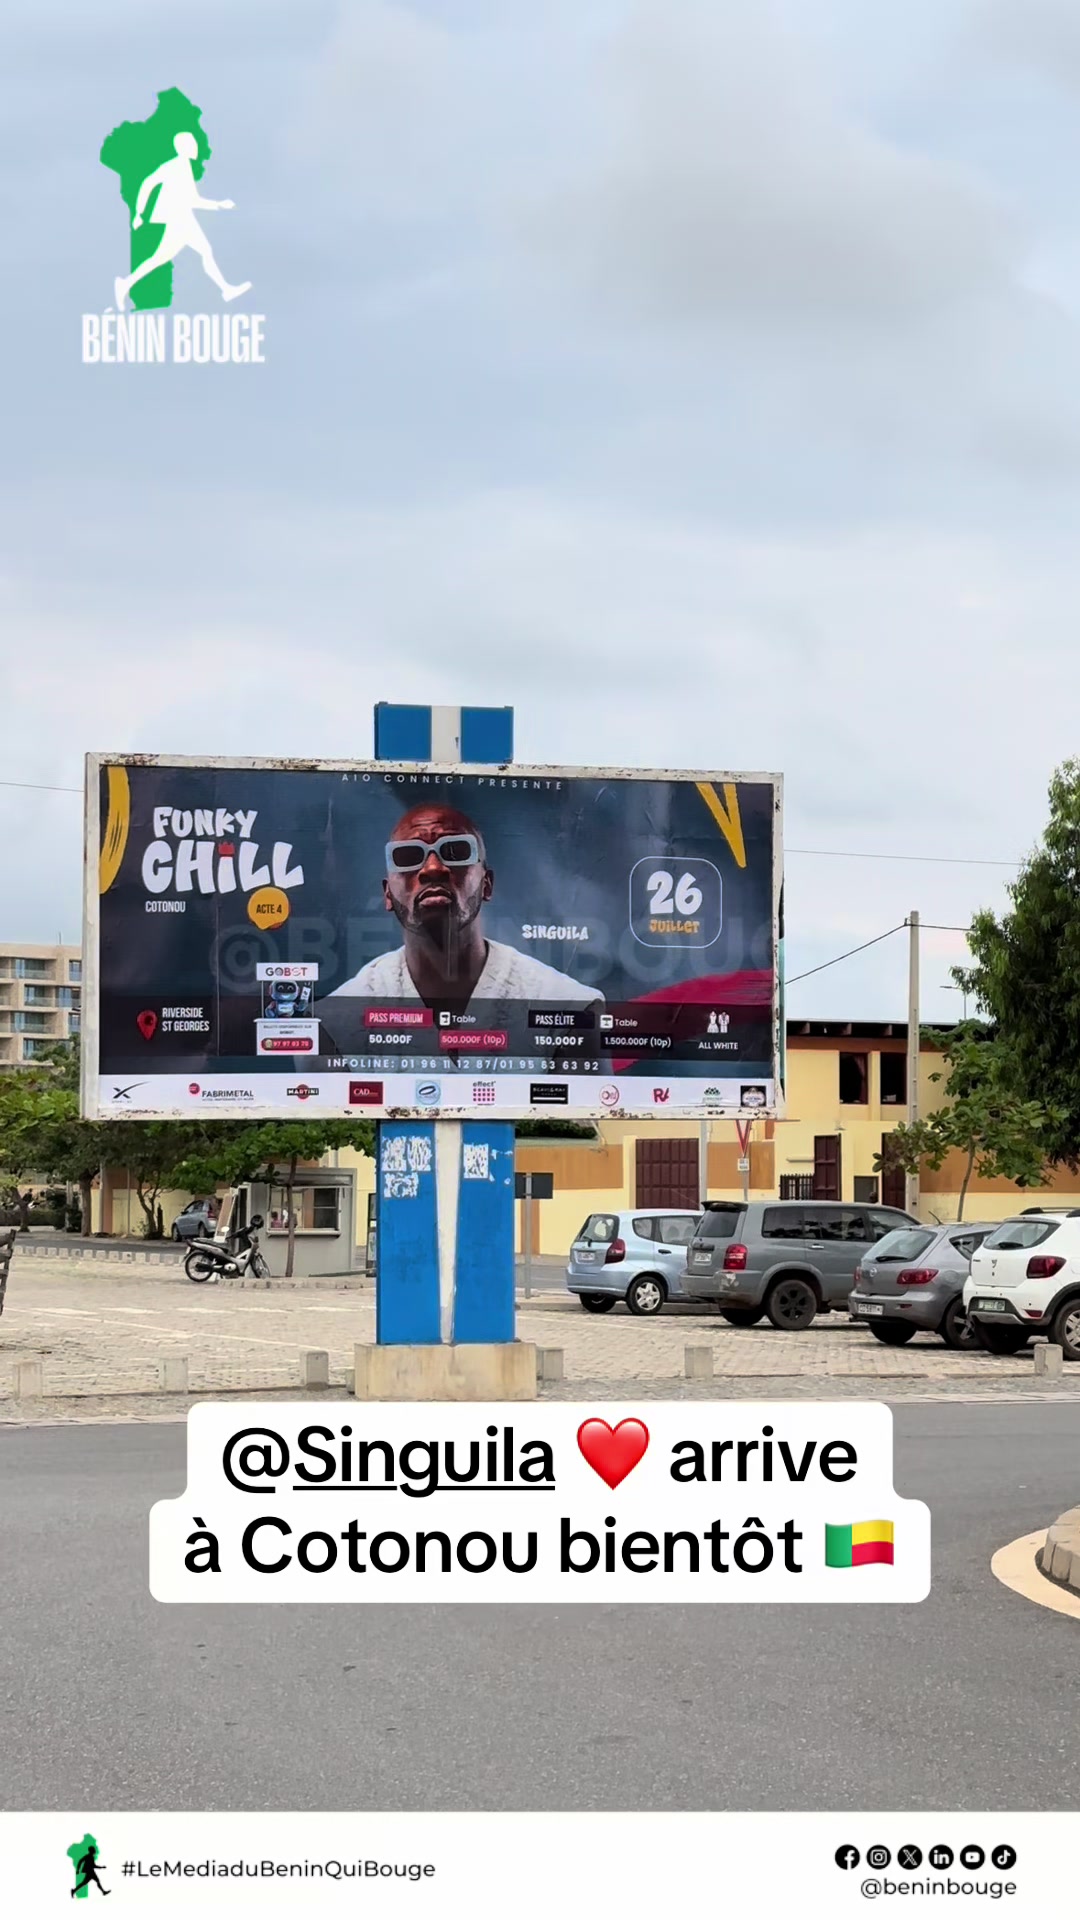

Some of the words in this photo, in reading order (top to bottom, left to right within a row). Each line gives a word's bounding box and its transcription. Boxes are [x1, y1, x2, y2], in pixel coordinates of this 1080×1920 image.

[384, 774, 464, 785] CONNECT
[478, 779, 562, 790] PRESENTE
[153, 806, 258, 838] FUNKY
[647, 870, 703, 916] 26
[145, 901, 186, 913] COTONOU
[256, 904, 275, 914] ACTE
[277, 904, 282, 914] 4
[265, 967, 308, 977] GOBOT
[162, 1007, 204, 1018] RIVERSIDE
[369, 1012, 388, 1023] PASS
[389, 1013, 424, 1024] PREMIUM
[452, 1014, 477, 1024] Table
[535, 1015, 553, 1026] PASS
[554, 1012, 575, 1026] ÉLITE
[614, 1018, 638, 1028] Table
[162, 1021, 173, 1031] ST
[174, 1021, 210, 1031] GEORGES
[369, 1034, 413, 1044] 50.000F
[441, 1035, 481, 1044] 500.000F
[483, 1035, 506, 1046] (10p)
[535, 1036, 576, 1046] 150.000
[604, 1037, 648, 1046] 1.500.000F
[650, 1037, 672, 1049] (10p)
[699, 1042, 713, 1050] ALL
[715, 1042, 739, 1050] WHITE
[327, 1058, 395, 1069] INFOLINE:
[401, 1059, 415, 1069] 01
[421, 1059, 437, 1069] 96
[443, 1060, 451, 1069] 11
[457, 1060, 470, 1069] 12
[519, 1061, 535, 1070] 95
[562, 1061, 578, 1071] 63
[584, 1062, 600, 1071] 92
[202, 1090, 254, 1098] FABRIMETAL
[353, 1088, 370, 1096] CAD
